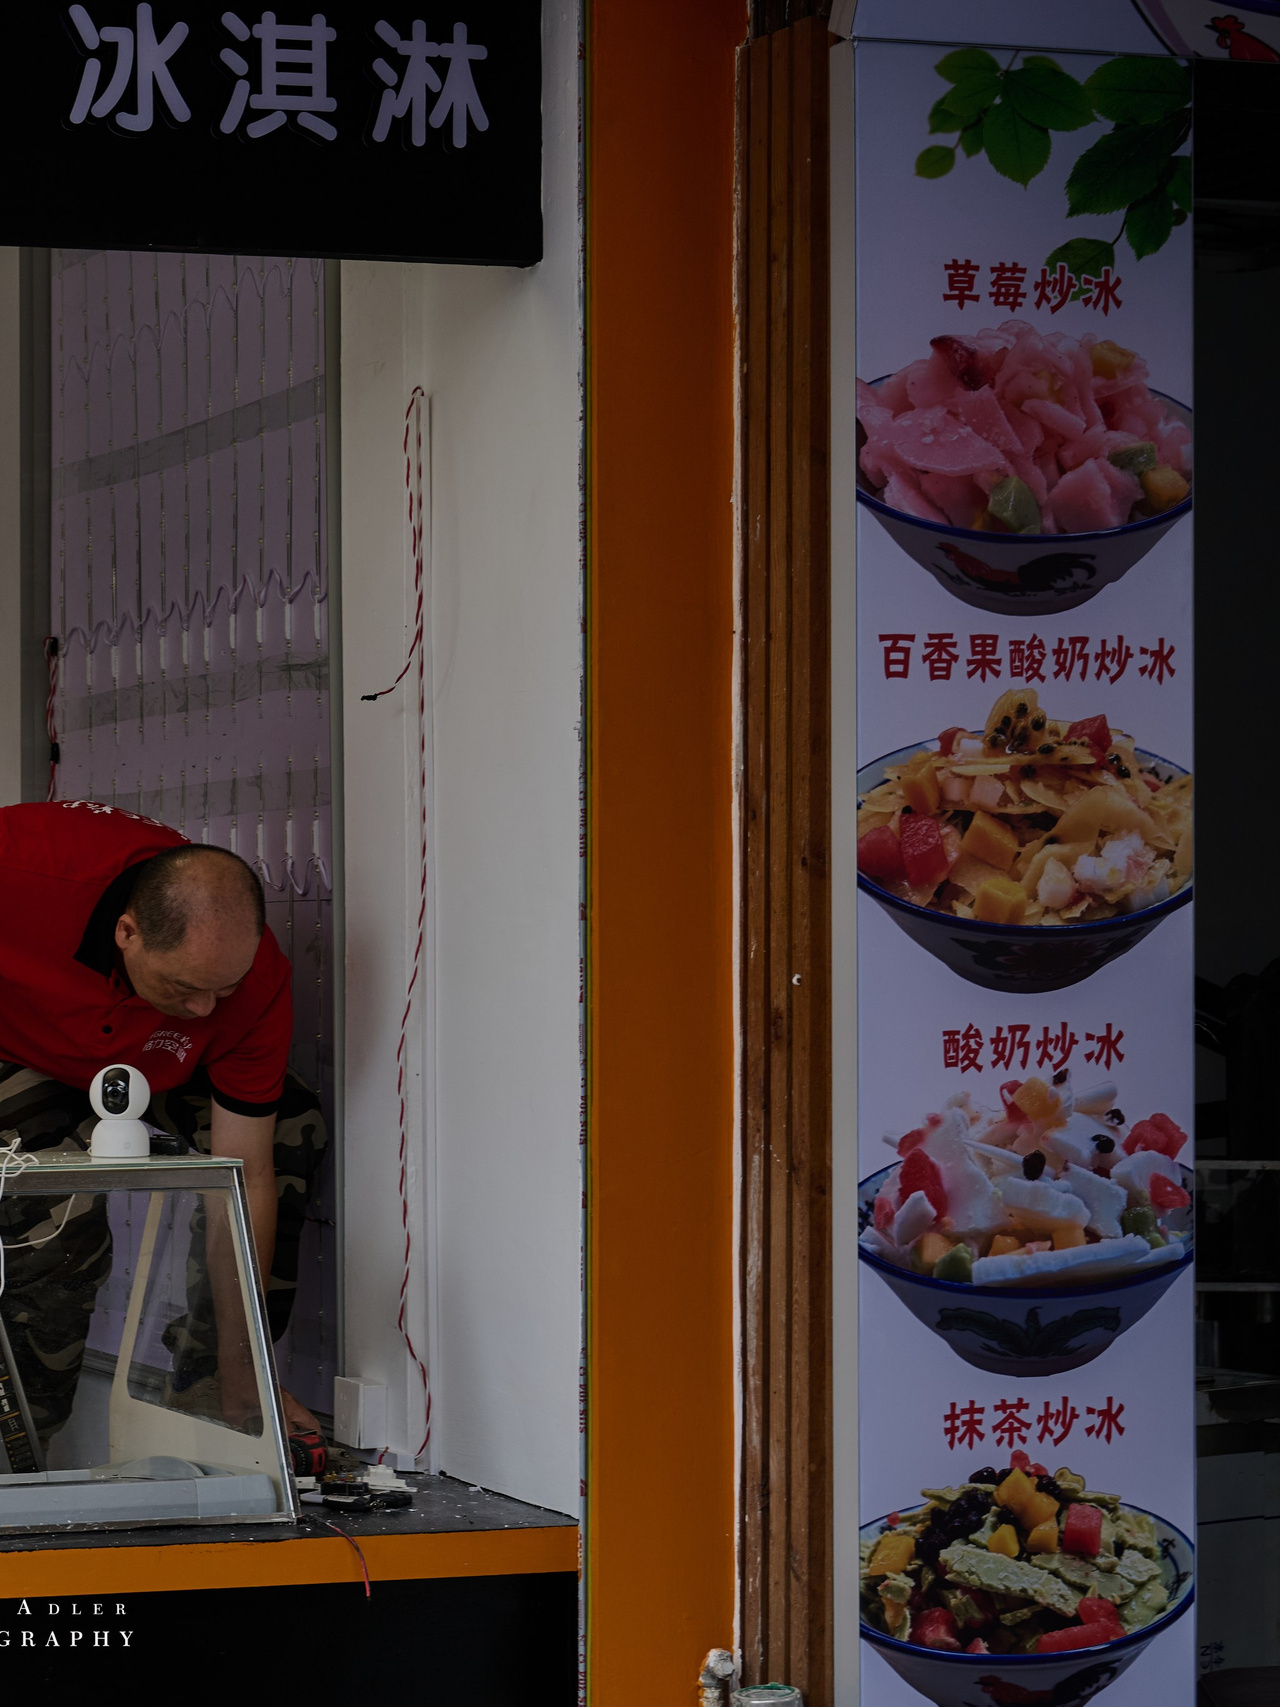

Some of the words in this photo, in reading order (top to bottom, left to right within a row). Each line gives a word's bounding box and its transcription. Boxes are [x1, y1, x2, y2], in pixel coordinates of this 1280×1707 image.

[943, 260, 1122, 316] 草莓炒冰
[878, 632, 1175, 683] 百香果酸奶炒冰
[943, 1022, 1125, 1072] 酸奶炒冰
[943, 1396, 1125, 1450] 抹茶炒冰
